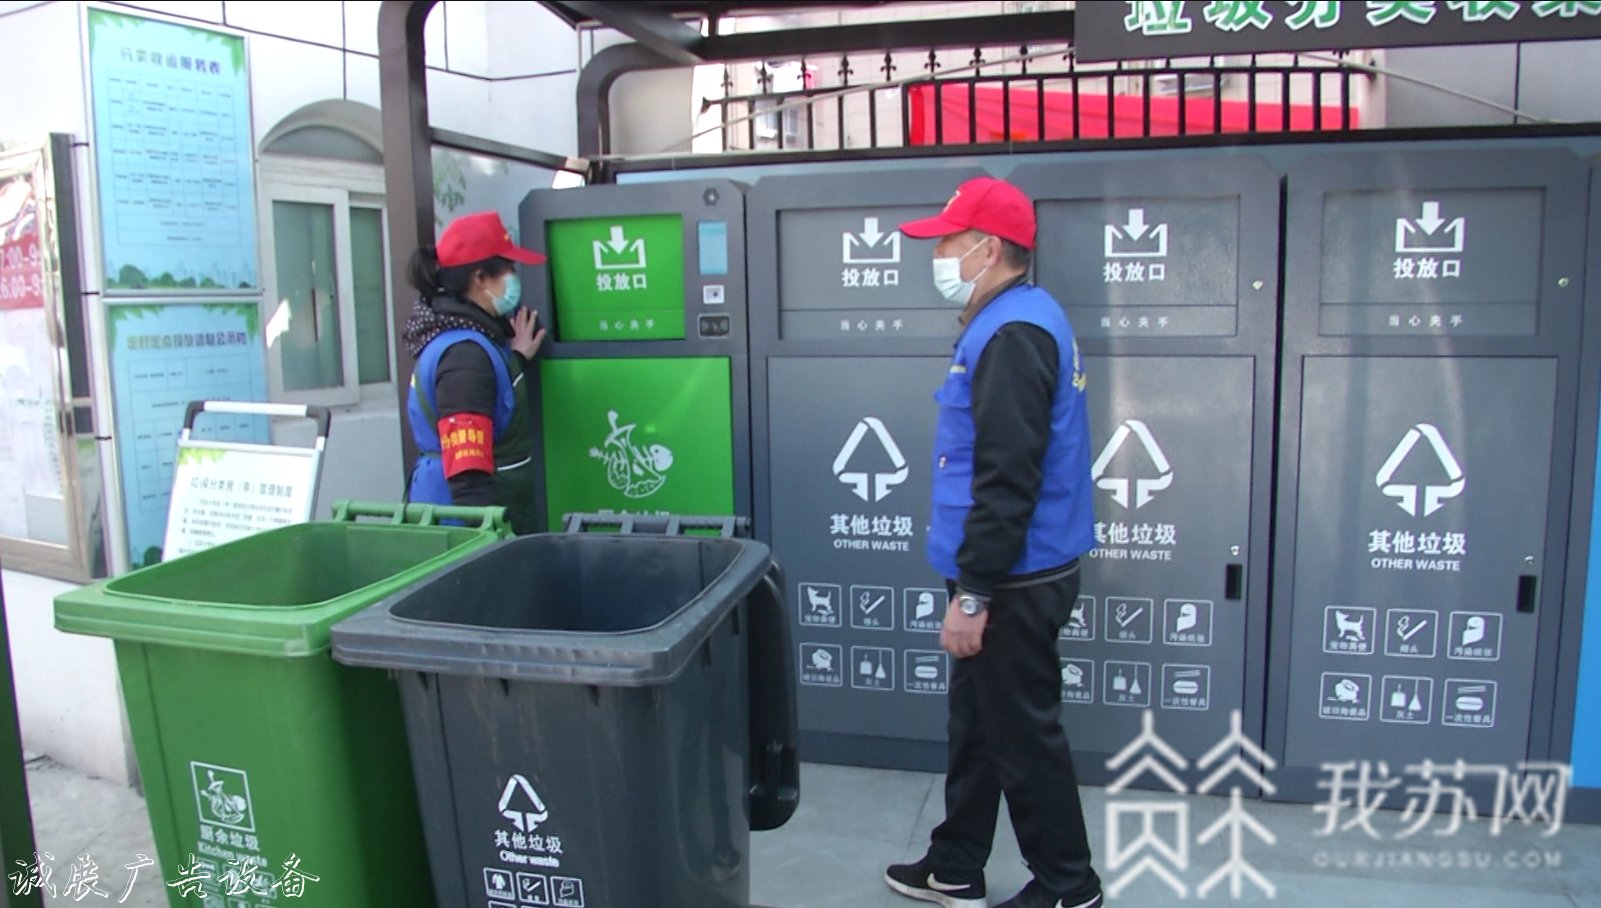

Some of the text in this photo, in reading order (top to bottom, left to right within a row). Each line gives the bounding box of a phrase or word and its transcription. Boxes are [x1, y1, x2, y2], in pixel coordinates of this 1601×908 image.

[841, 267, 899, 288] 投放口
[1103, 261, 1166, 283] 投放口
[1393, 257, 1461, 279] 投放口
[596, 272, 647, 292] 投放口
[840, 319, 903, 331] 当心夹手
[1100, 315, 1169, 329] 当心夹手
[1388, 313, 1463, 328] 当心夹手
[829, 513, 914, 536] 其他垃圾
[833, 538, 910, 552] OTHER WASTE
[1367, 529, 1467, 555] 其他垃圾
[1088, 547, 1172, 561] OTHER WASTE
[1370, 557, 1461, 572] OTHER WASTE
[494, 829, 563, 854] 其他垃圾
